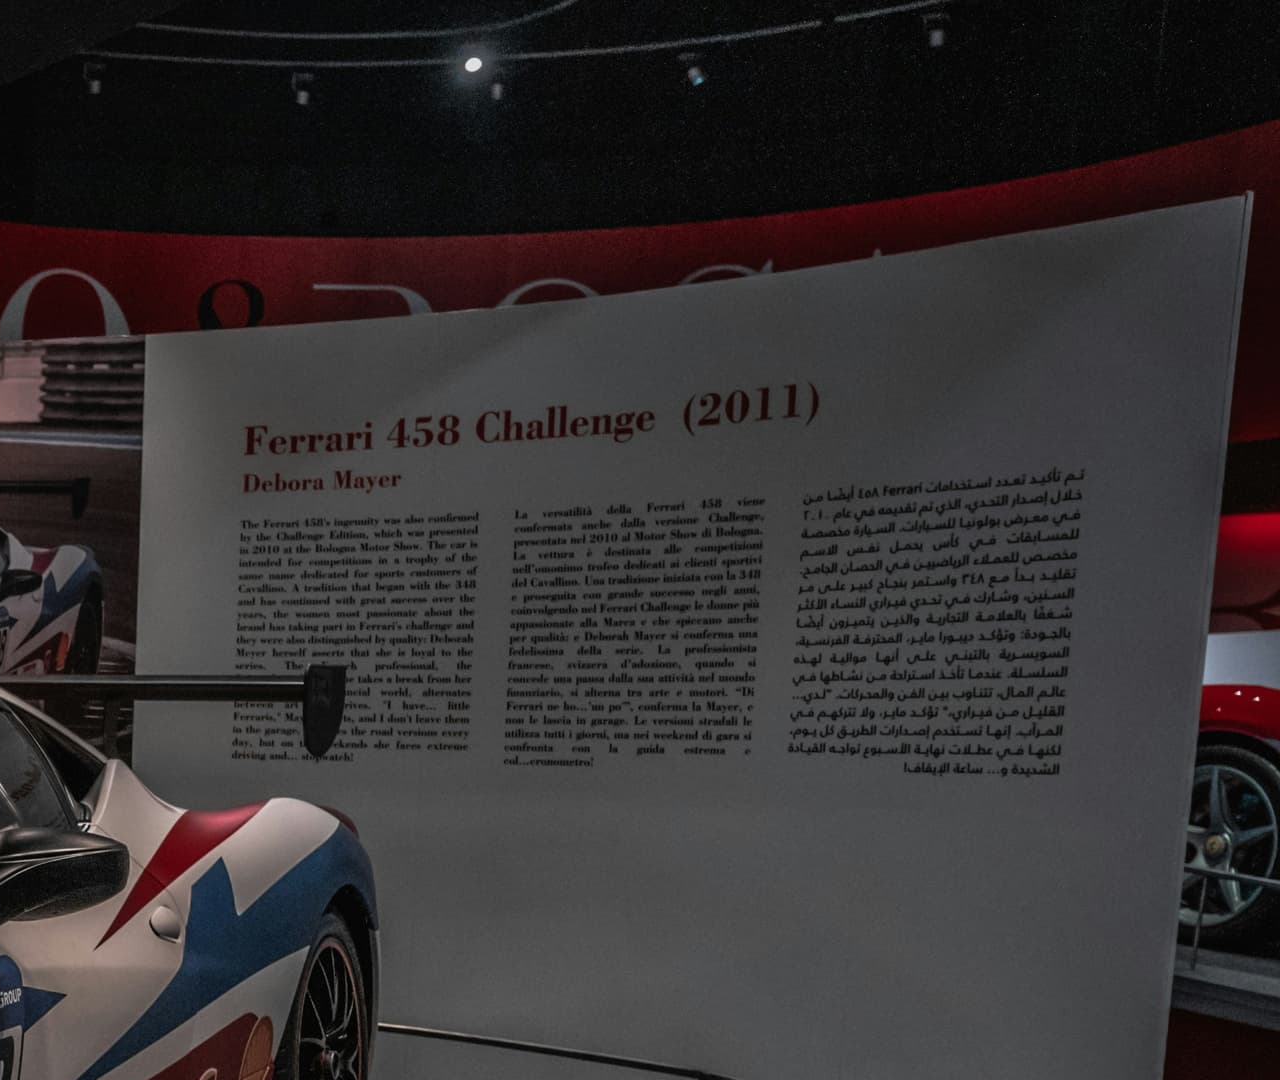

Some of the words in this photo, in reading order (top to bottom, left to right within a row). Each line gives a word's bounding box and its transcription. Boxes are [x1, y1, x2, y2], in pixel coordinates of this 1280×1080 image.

[244, 418, 374, 456] Ferrari
[386, 414, 464, 449] 458
[475, 400, 657, 447] Challenge
[678, 381, 823, 437] (2011)
[243, 472, 328, 495] Debora
[331, 469, 402, 494] Mayer
[924, 476, 992, 494] استخدامات
[994, 474, 1027, 488] تعدد
[1028, 471, 1063, 486] تأكيد
[1063, 469, 1086, 486] تم
[882, 482, 923, 496] Ferrari
[514, 509, 528, 520] La
[542, 506, 592, 518] versatilità
[606, 504, 634, 515] della
[647, 500, 685, 512] Ferrari
[700, 498, 722, 510] 458
[736, 497, 766, 507] viene
[803, 494, 824, 506] من
[240, 520, 260, 530] The
[263, 519, 300, 528] Ferrari
[303, 517, 331, 528] 458's
[334, 517, 380, 528] ingenuity
[384, 518, 401, 526] was
[404, 514, 424, 524] also
[428, 512, 480, 524] confirmed
[240, 532, 251, 544] by
[256, 532, 272, 542] the
[276, 531, 325, 542] Challenge
[329, 530, 369, 540] Edition,
[374, 528, 403, 539] which
[429, 525, 478, 539] presented
